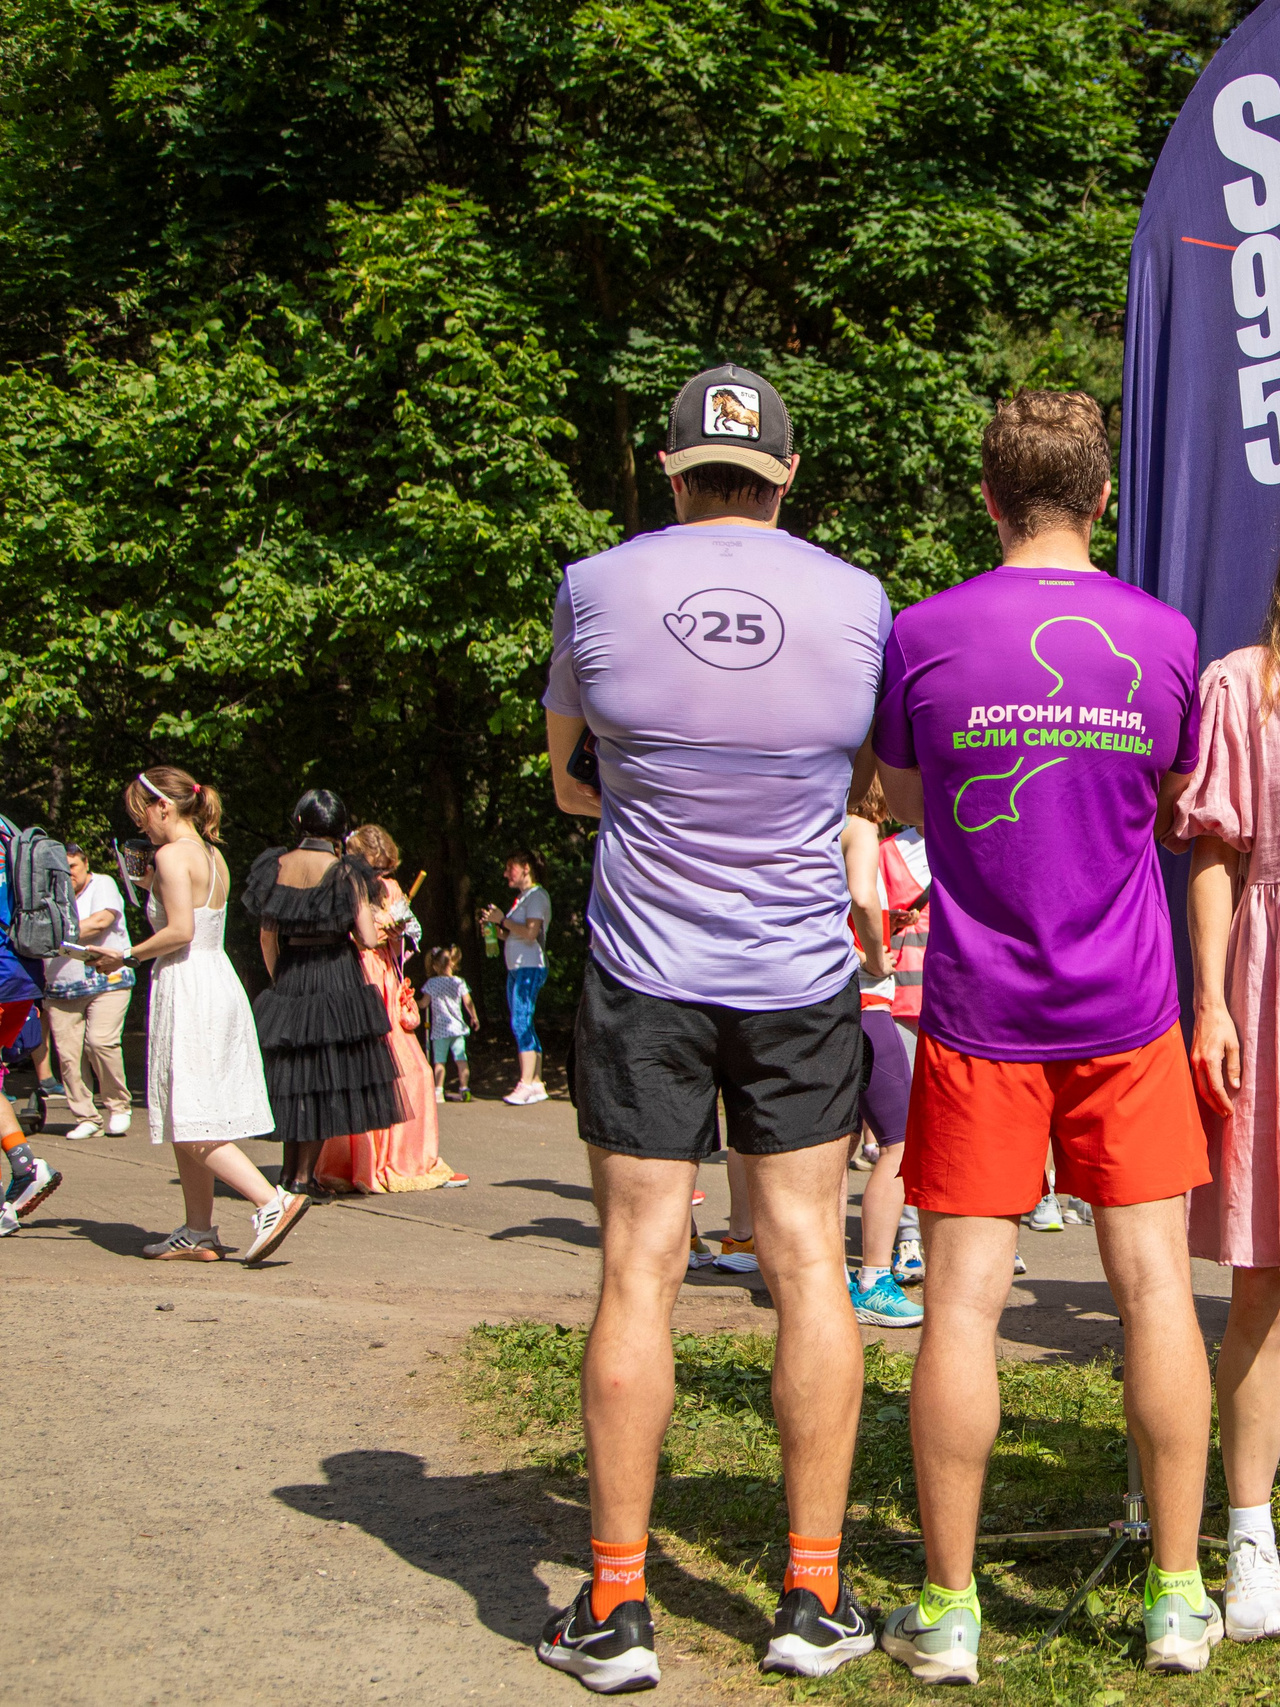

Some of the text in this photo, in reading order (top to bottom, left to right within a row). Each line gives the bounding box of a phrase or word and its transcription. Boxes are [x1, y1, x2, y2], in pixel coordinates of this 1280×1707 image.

[702, 610, 766, 645] 25
[967, 704, 1147, 734] ДОГОНИ МЕНЯ,
[952, 728, 1154, 756] ЕСЛИ СМОЖЕШЬ!
[601, 1566, 645, 1584] Вёрс
